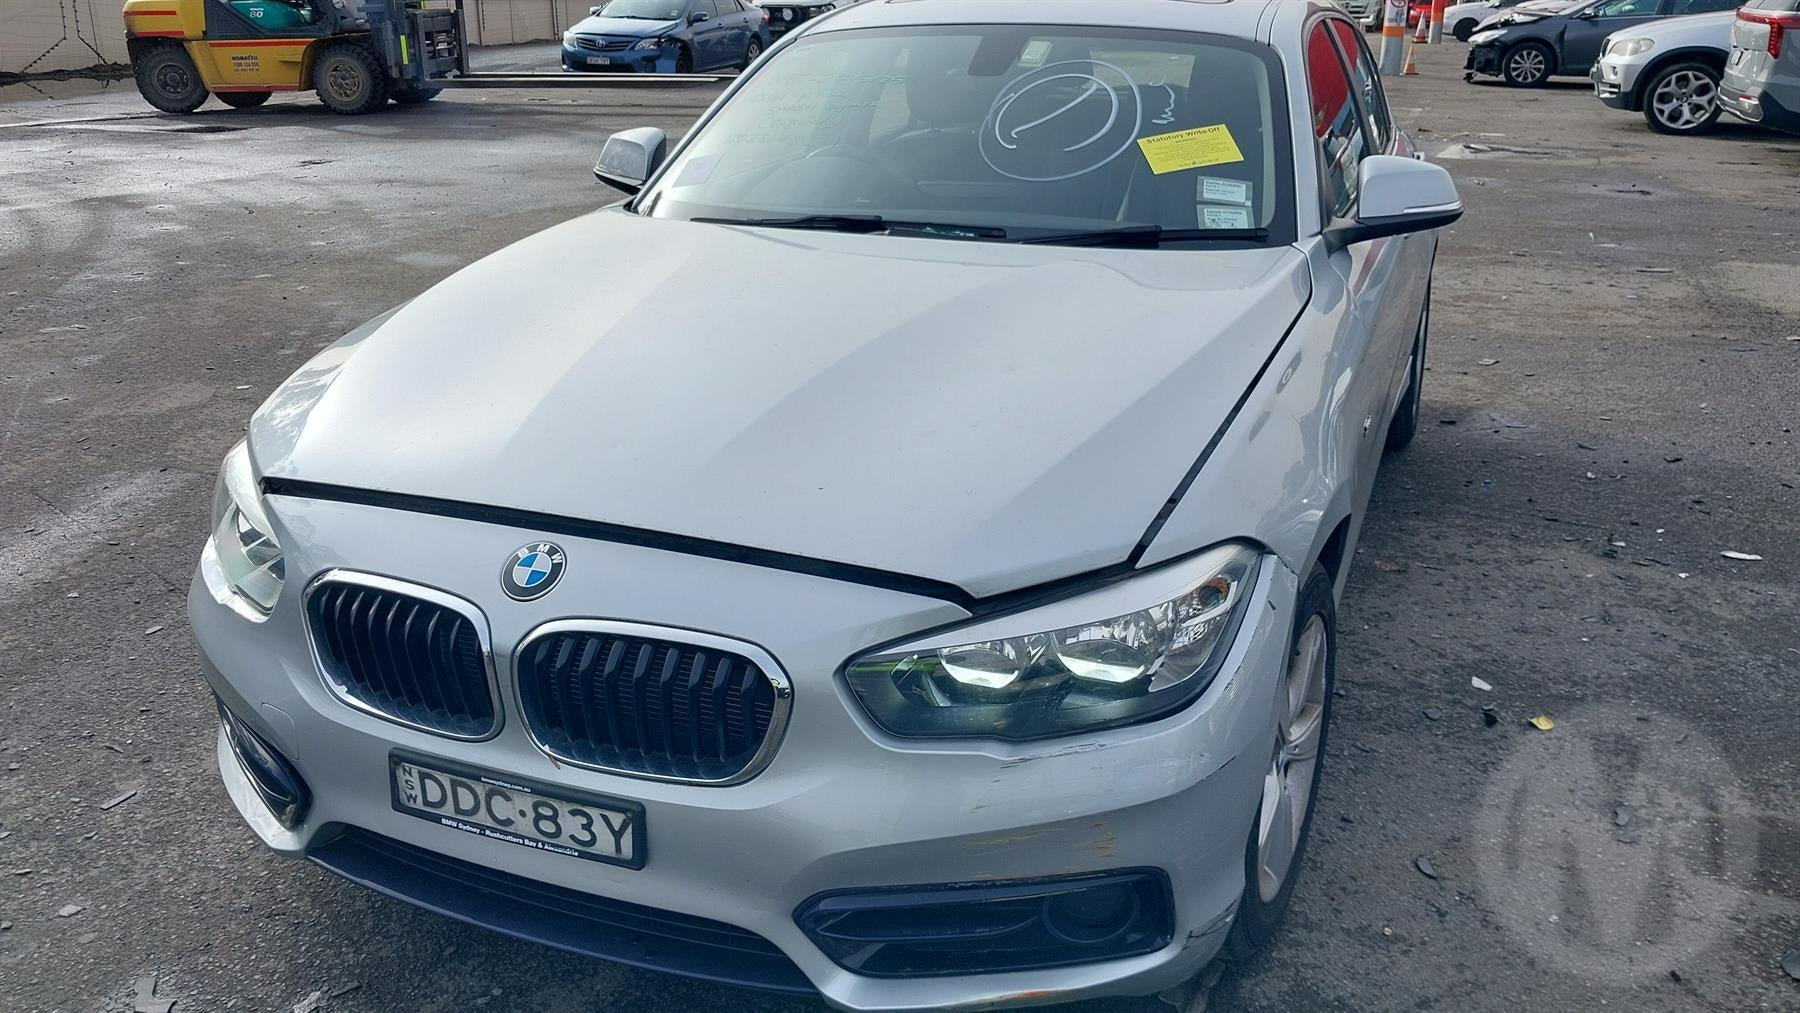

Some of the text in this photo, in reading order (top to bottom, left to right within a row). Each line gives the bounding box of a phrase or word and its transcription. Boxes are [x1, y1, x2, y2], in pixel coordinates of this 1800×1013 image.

[250, 10, 264, 18] 80
[1147, 133, 1184, 144] Statutory
[1184, 126, 1220, 138] Write-Off
[516, 543, 563, 564] BMW
[402, 765, 419, 805] NSW
[441, 817, 457, 829] BMW
[458, 821, 480, 834] Sydney
[485, 829, 524, 845] Rushcutters
[524, 839, 537, 849] Bay
